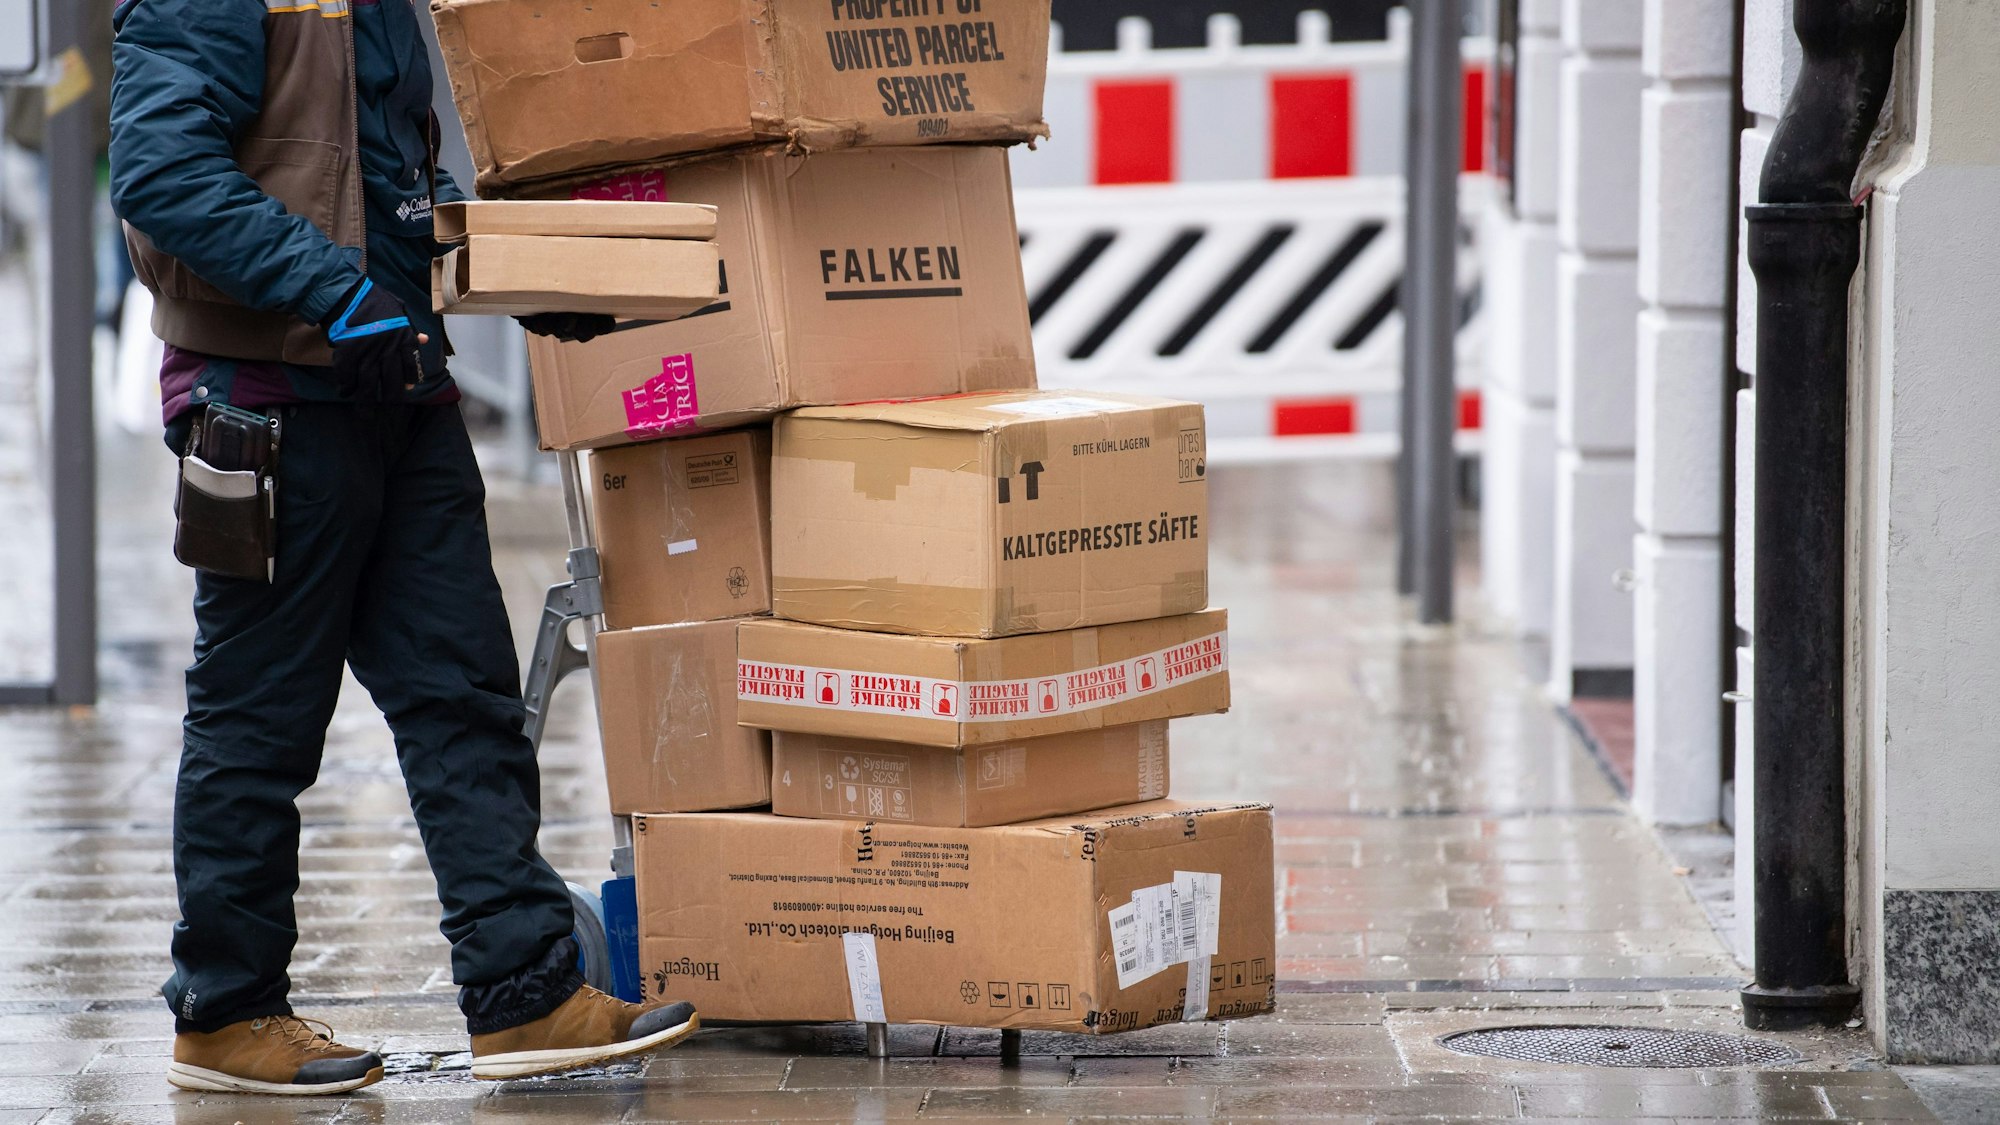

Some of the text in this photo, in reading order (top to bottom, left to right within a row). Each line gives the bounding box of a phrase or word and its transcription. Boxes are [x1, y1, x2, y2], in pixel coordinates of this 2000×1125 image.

[826, 22, 1004, 72] UNITED PARCEL
[877, 73, 975, 116] SERVICE
[820, 246, 960, 284] FALKEN
[1073, 436, 1150, 456] BITTE KÜHL LAGERN
[1178, 453, 1195, 479] bar
[603, 473, 627, 491] 6er
[1003, 512, 1198, 561] KALTGEPRESSTE SÄFTE
[1163, 636, 1221, 665] FRAGILE
[739, 664, 804, 682] FRAGILE
[1165, 652, 1222, 684] KŘEHKÉ
[851, 675, 921, 694] FRAGILE
[1067, 665, 1125, 689] FRAGILE
[739, 680, 804, 701] KŘEHKÉ
[969, 683, 1029, 699] FRAGILE
[1068, 681, 1127, 708] KŘEHKÉ
[851, 691, 921, 712] KŘEHKÉ
[969, 699, 1029, 718] KŘEHKÉ
[782, 770, 791, 787] 4
[825, 774, 833, 790] 3
[872, 770, 900, 784] SC/SA
[941, 843, 969, 851] Website:
[940, 852, 953, 860] +86
[851, 867, 873, 875] China.
[873, 868, 886, 876] P.R.
[923, 861, 930, 869] 10
[946, 862, 969, 870] Phone:
[728, 873, 754, 882] District,
[756, 873, 778, 882] Daxing
[797, 875, 833, 884] Biomedical
[834, 876, 856, 884] Street,
[857, 877, 878, 885] Tianfu
[879, 878, 883, 886] 9
[884, 878, 895, 886] No.
[913, 870, 939, 879] Beijing,
[898, 878, 927, 888] Building,
[856, 904, 887, 913] service
[888, 906, 906, 915] free
[907, 907, 923, 916] The
[744, 922, 797, 937] Co.,Ltd.
[853, 923, 901, 942] Hotgen
[905, 926, 955, 944] Beijing
[663, 957, 720, 981] Hotgen
